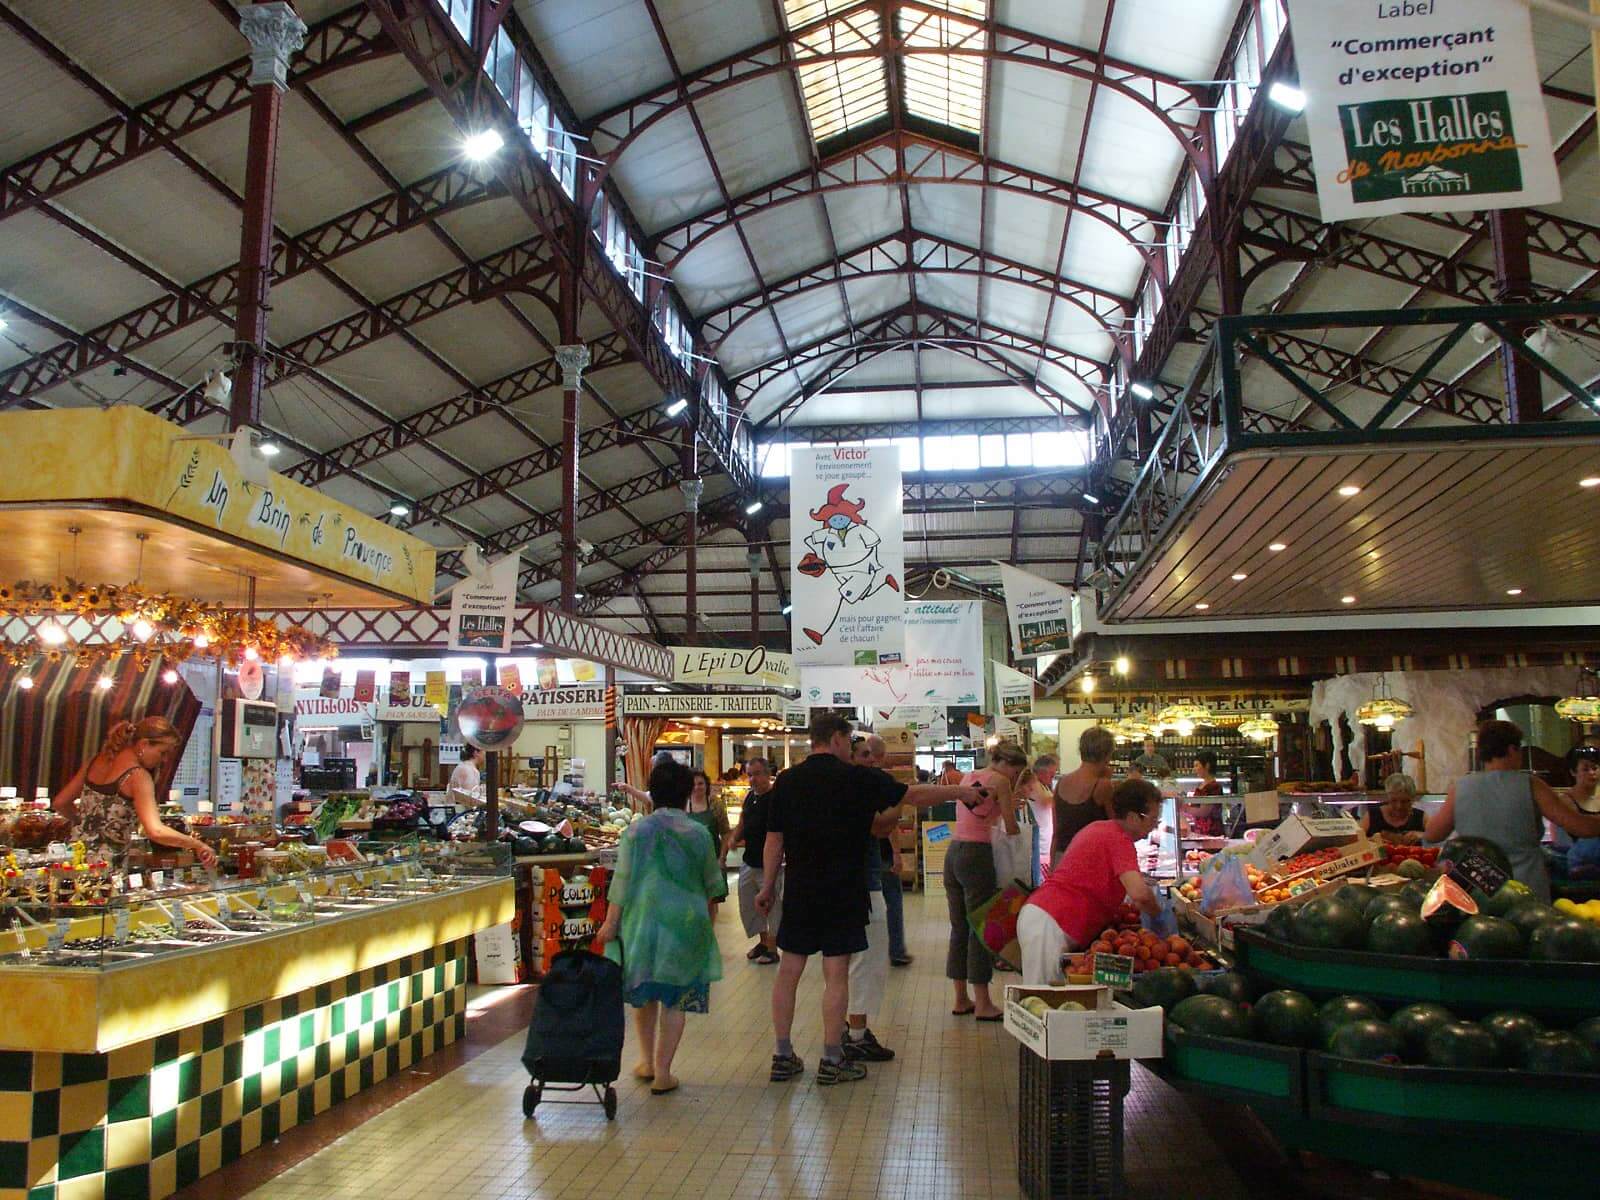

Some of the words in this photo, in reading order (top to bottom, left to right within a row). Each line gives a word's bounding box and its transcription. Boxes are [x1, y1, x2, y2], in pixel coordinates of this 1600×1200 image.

[1377, 0, 1434, 19] Label
[1347, 104, 1402, 149] Les
[1409, 95, 1504, 144] Halles
[816, 453, 831, 461] Avec
[833, 448, 867, 460] Victor
[824, 473, 839, 481] joue
[258, 491, 292, 547] Brin
[312, 515, 324, 545] de
[342, 527, 393, 583] Provence
[858, 616, 874, 625] pour
[839, 634, 848, 642] de
[850, 634, 873, 642] chacun
[627, 696, 650, 711] PAIN
[658, 696, 713, 711] PATISSERIE
[720, 696, 772, 711] TRAITEUR
